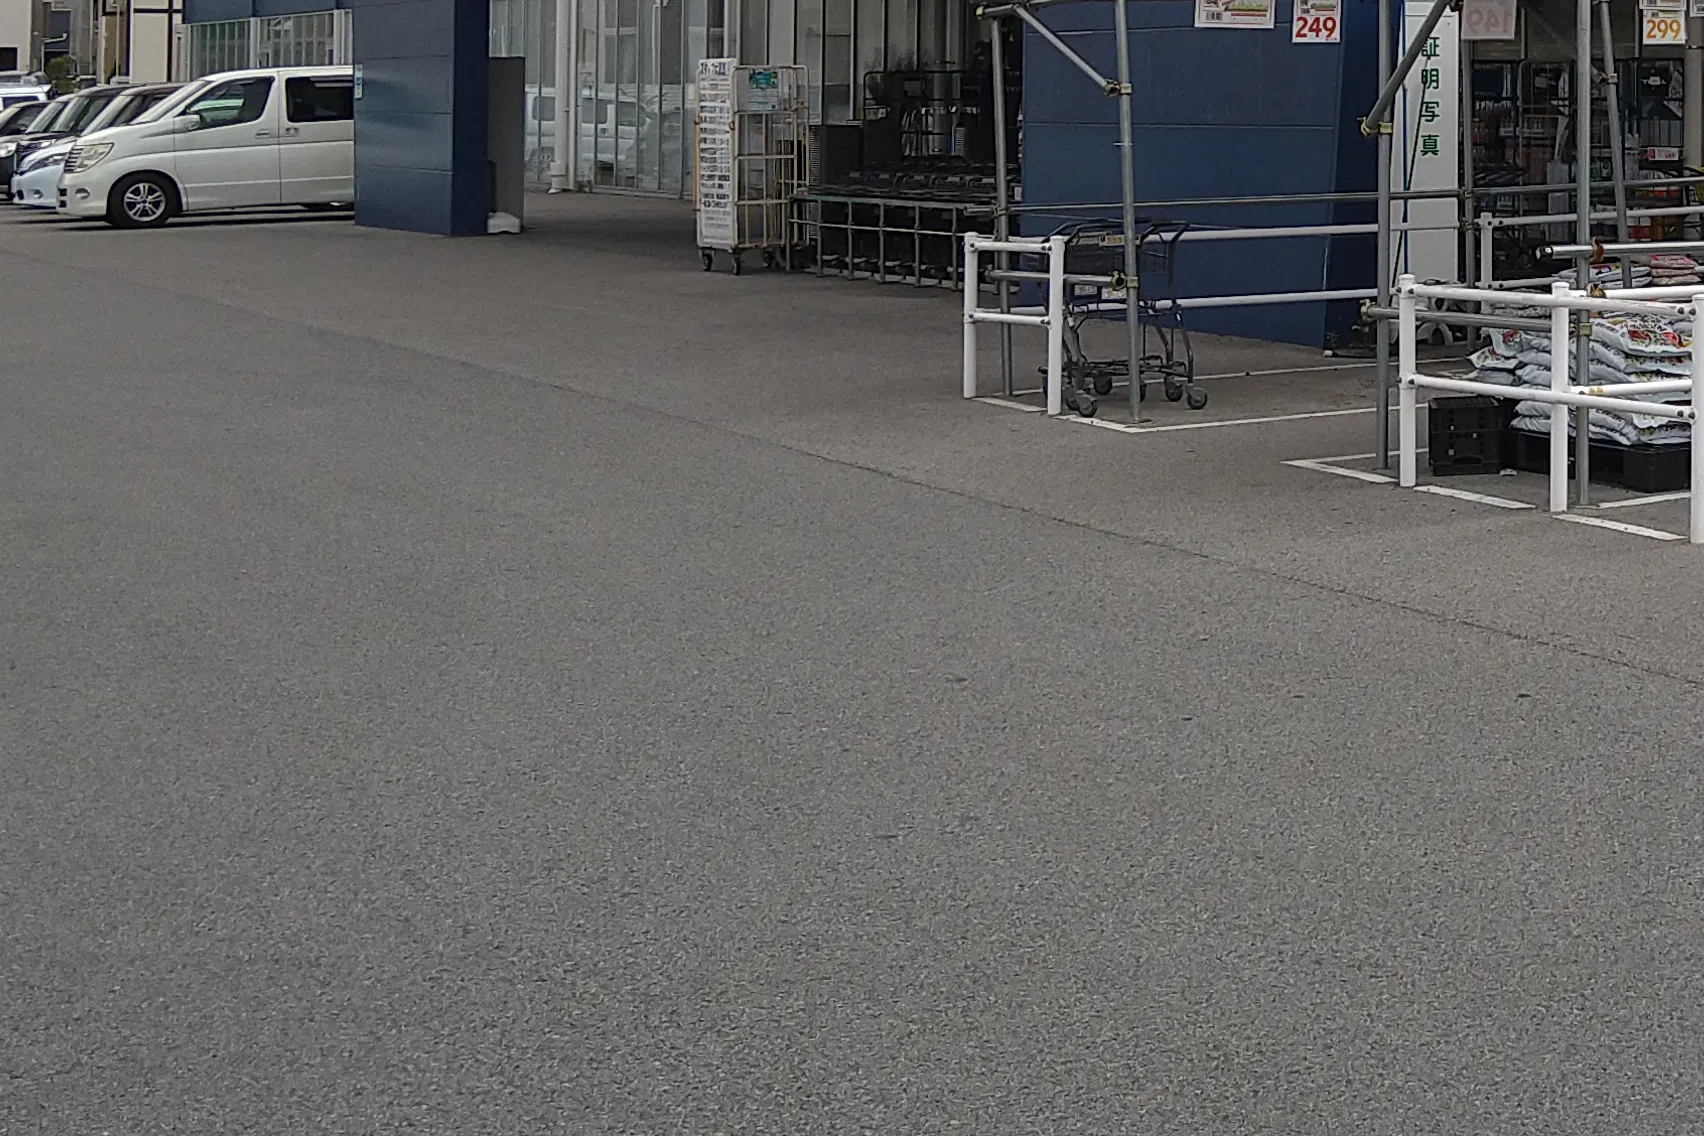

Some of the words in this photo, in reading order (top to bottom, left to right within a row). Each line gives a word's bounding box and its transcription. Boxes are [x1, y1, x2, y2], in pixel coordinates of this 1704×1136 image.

[1295, 16, 1337, 38] 249
[1646, 19, 1681, 41] 299
[1420, 36, 1440, 156] 証明写真
